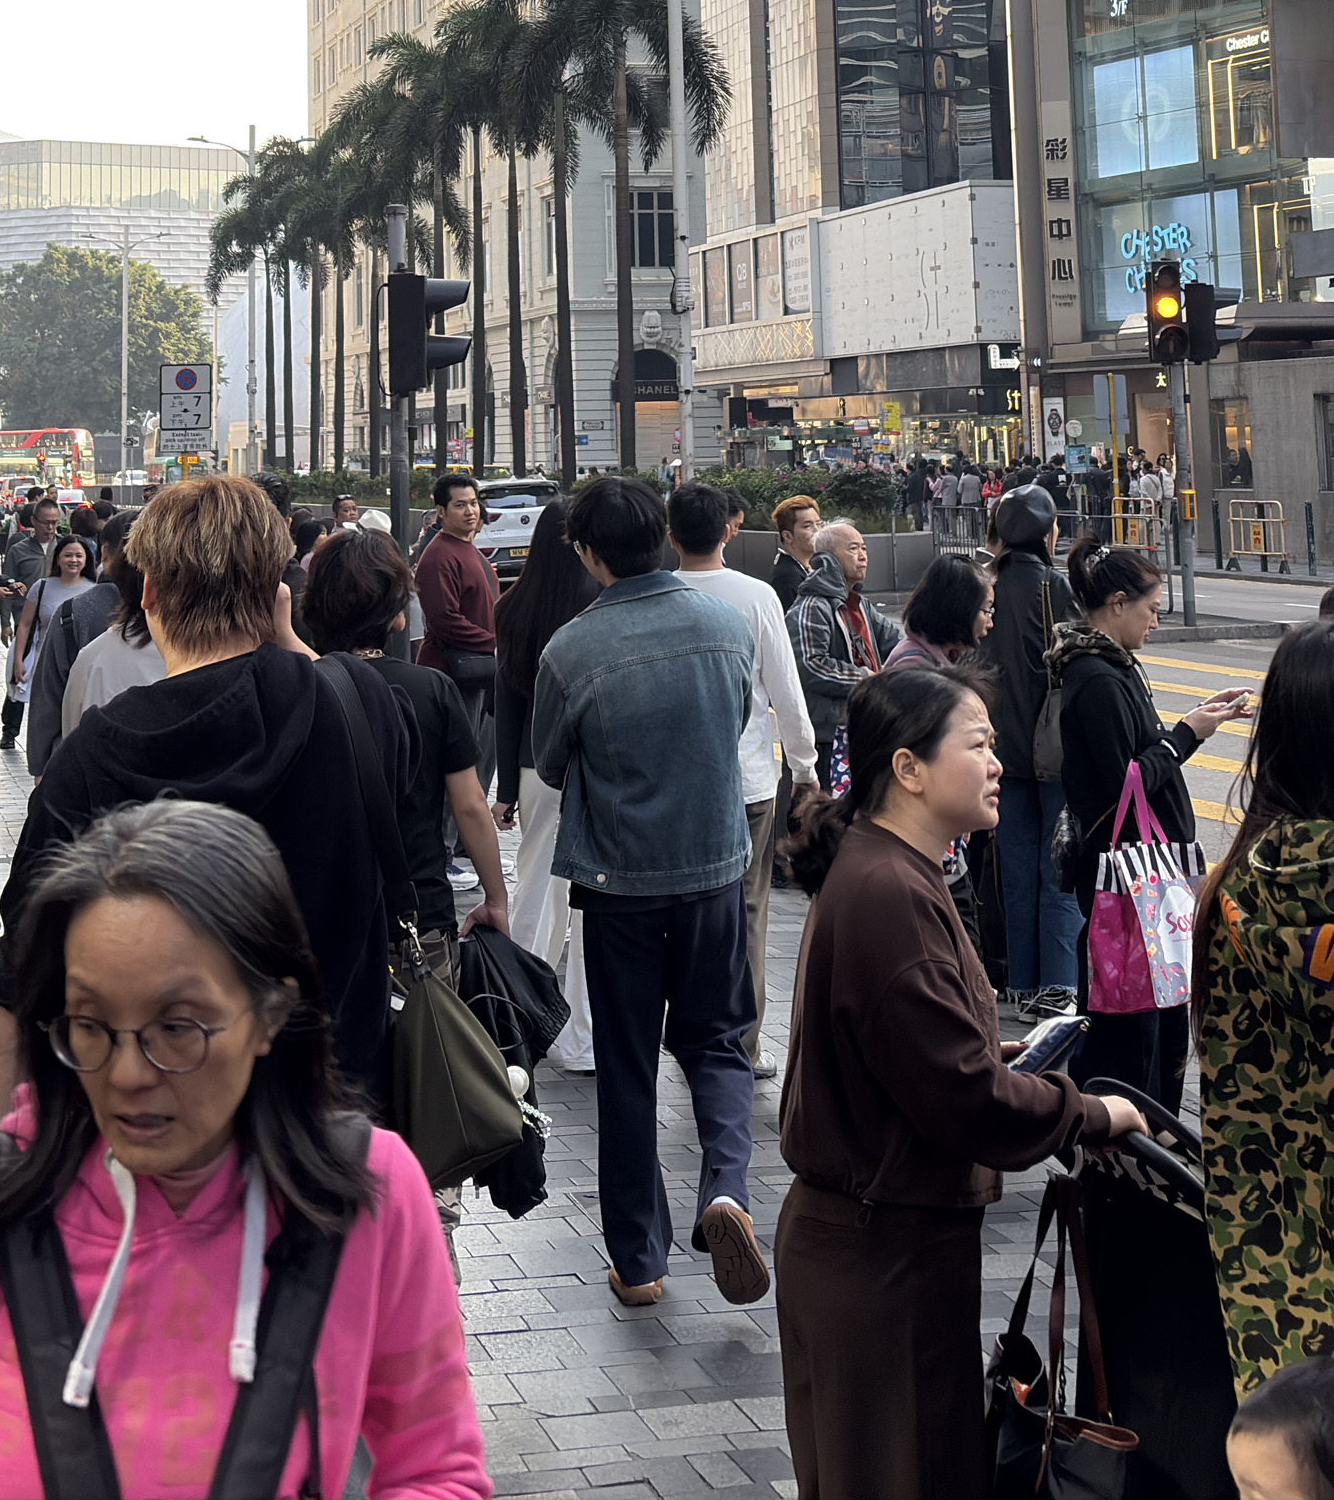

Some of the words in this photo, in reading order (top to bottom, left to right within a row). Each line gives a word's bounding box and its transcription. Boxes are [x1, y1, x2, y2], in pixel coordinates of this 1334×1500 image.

[1226, 33, 1260, 51] Chester
[1045, 137, 1074, 281] 彩星中心
[1121, 222, 1192, 260] CHESTER
[736, 263, 747, 281] QB
[193, 395, 202, 407] 7
[193, 414, 202, 425] 7
